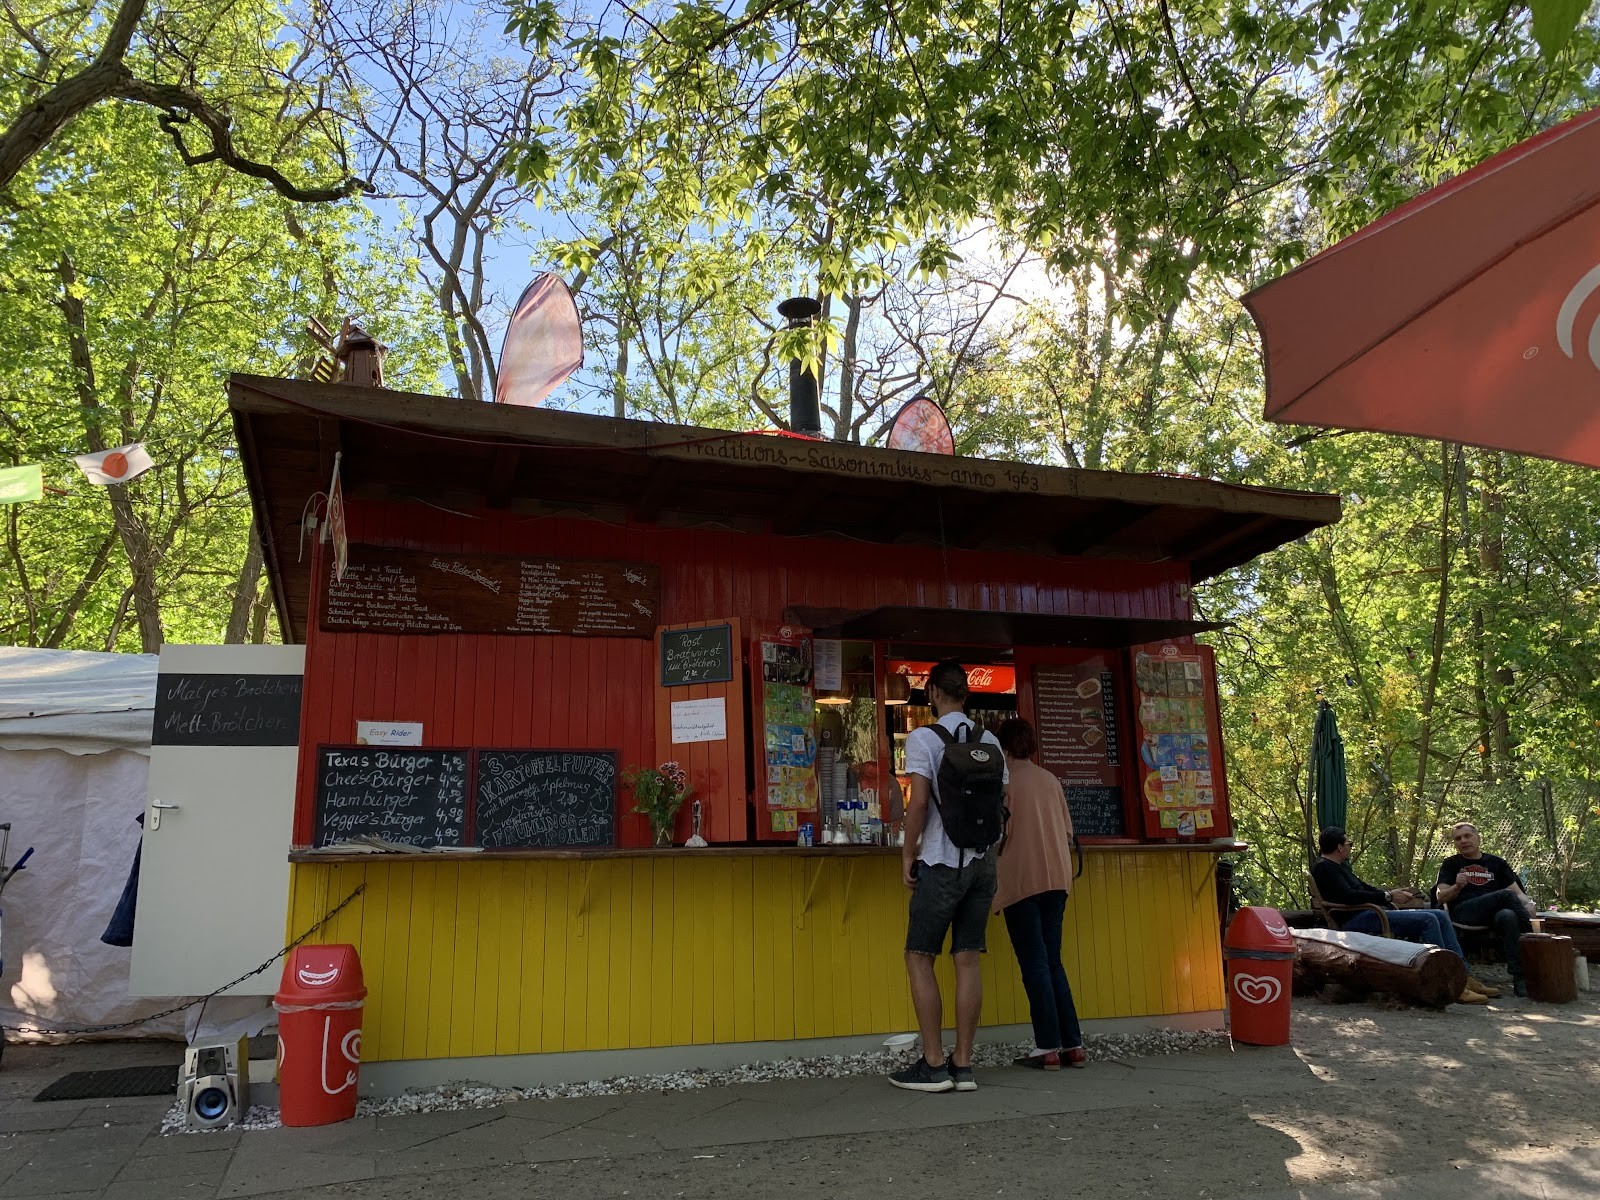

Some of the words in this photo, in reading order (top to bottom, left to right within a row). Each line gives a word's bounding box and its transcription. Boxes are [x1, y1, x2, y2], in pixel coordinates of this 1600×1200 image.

[1005, 469, 1040, 492] 1963
[384, 565, 402, 575] Toast
[431, 558, 450, 571] Easy
[452, 561, 471, 575] Rider
[328, 588, 374, 599] Rostbratwurst
[400, 584, 418, 593] Toast
[328, 598, 351, 607] Wiener
[366, 601, 397, 610] Bockwurst
[412, 603, 429, 611] Toast
[518, 605, 549, 615] Hamburger
[328, 616, 351, 624] Chicken
[353, 617, 370, 628] Wings
[382, 619, 405, 631] Country
[680, 634, 704, 647] Rost
[967, 667, 995, 686] Cola
[168, 678, 230, 712] Matjes
[369, 728, 388, 737] Easy
[390, 729, 412, 738] Rider
[326, 753, 370, 768] Texas
[487, 758, 504, 775] 3
[484, 803, 499, 818] mit
[545, 825, 601, 846] ROLLEN
